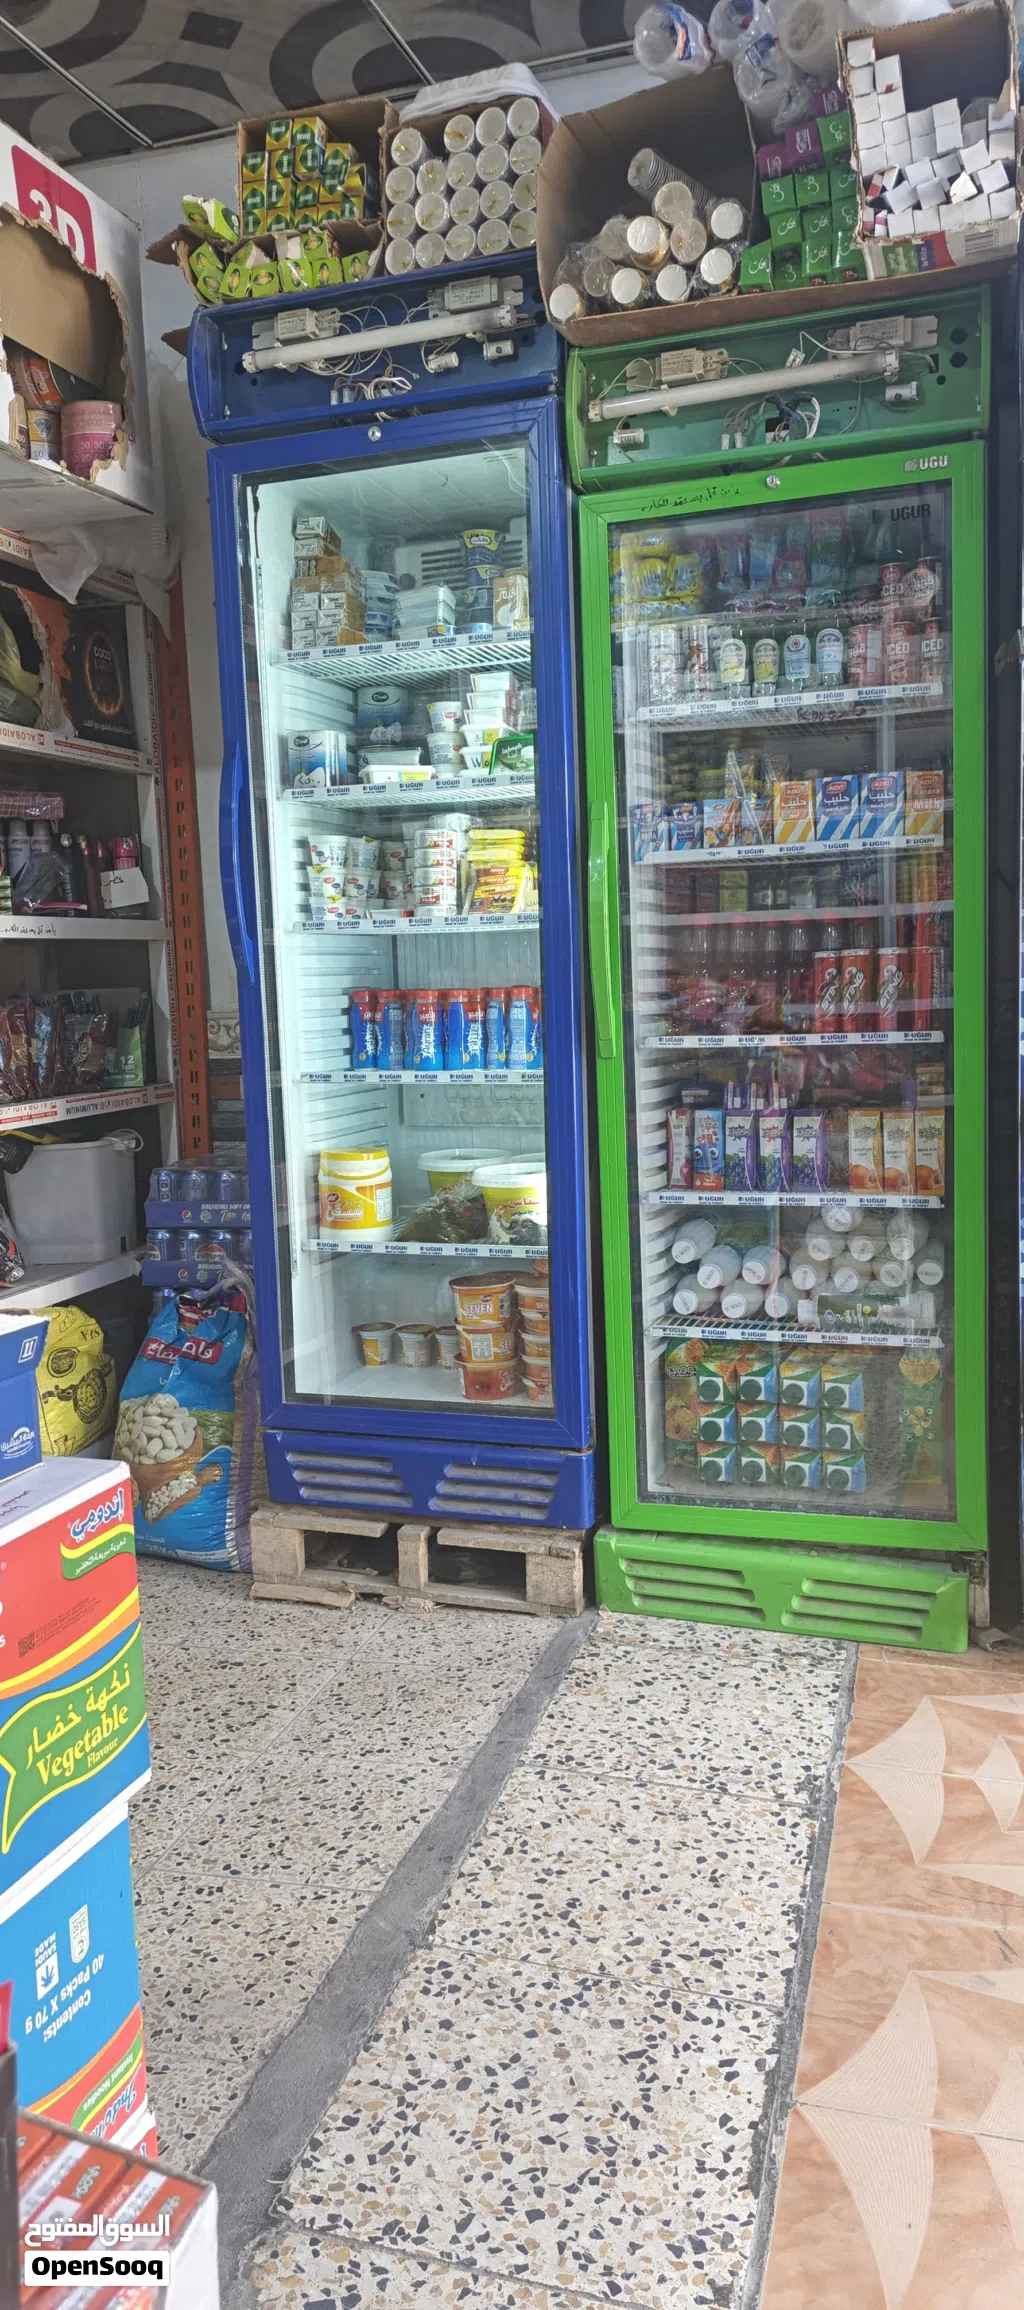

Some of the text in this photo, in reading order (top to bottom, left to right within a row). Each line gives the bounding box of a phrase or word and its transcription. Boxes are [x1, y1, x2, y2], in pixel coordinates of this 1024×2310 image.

[919, 455, 948, 470] UGU
[890, 503, 931, 522] UGUR
[93, 646, 111, 661] COCO
[886, 642, 910, 657] ICED
[921, 638, 943, 654] ICED
[829, 783, 845, 791] KDD
[874, 778, 891, 786] KDD
[823, 792, 850, 805] حليب
[868, 788, 895, 801] حليب
[781, 796, 806, 809] حليب
[120, 1055, 135, 1065] 12
[65, 1102, 99, 1115] ALUMINUM
[201, 1203, 229, 1211] BAGHDAD
[464, 1304, 494, 1315] SEVEN
[536, 1301, 549, 1310] SEV
[70, 1487, 125, 1544] إندومي
[94, 1549, 111, 1561] سريعة
[26, 1662, 131, 1771] نكهة خضار
[36, 1703, 129, 1786] Vegetable
[87, 1737, 119, 1769] Flavour
[34, 1931, 57, 1958] MADE
[35, 1942, 57, 1968] SAUDI
[25, 1953, 105, 2036] 40 Packs X 70 g
[43, 1988, 91, 2044] Contents:
[83, 2052, 134, 2113] Instant Noodles
